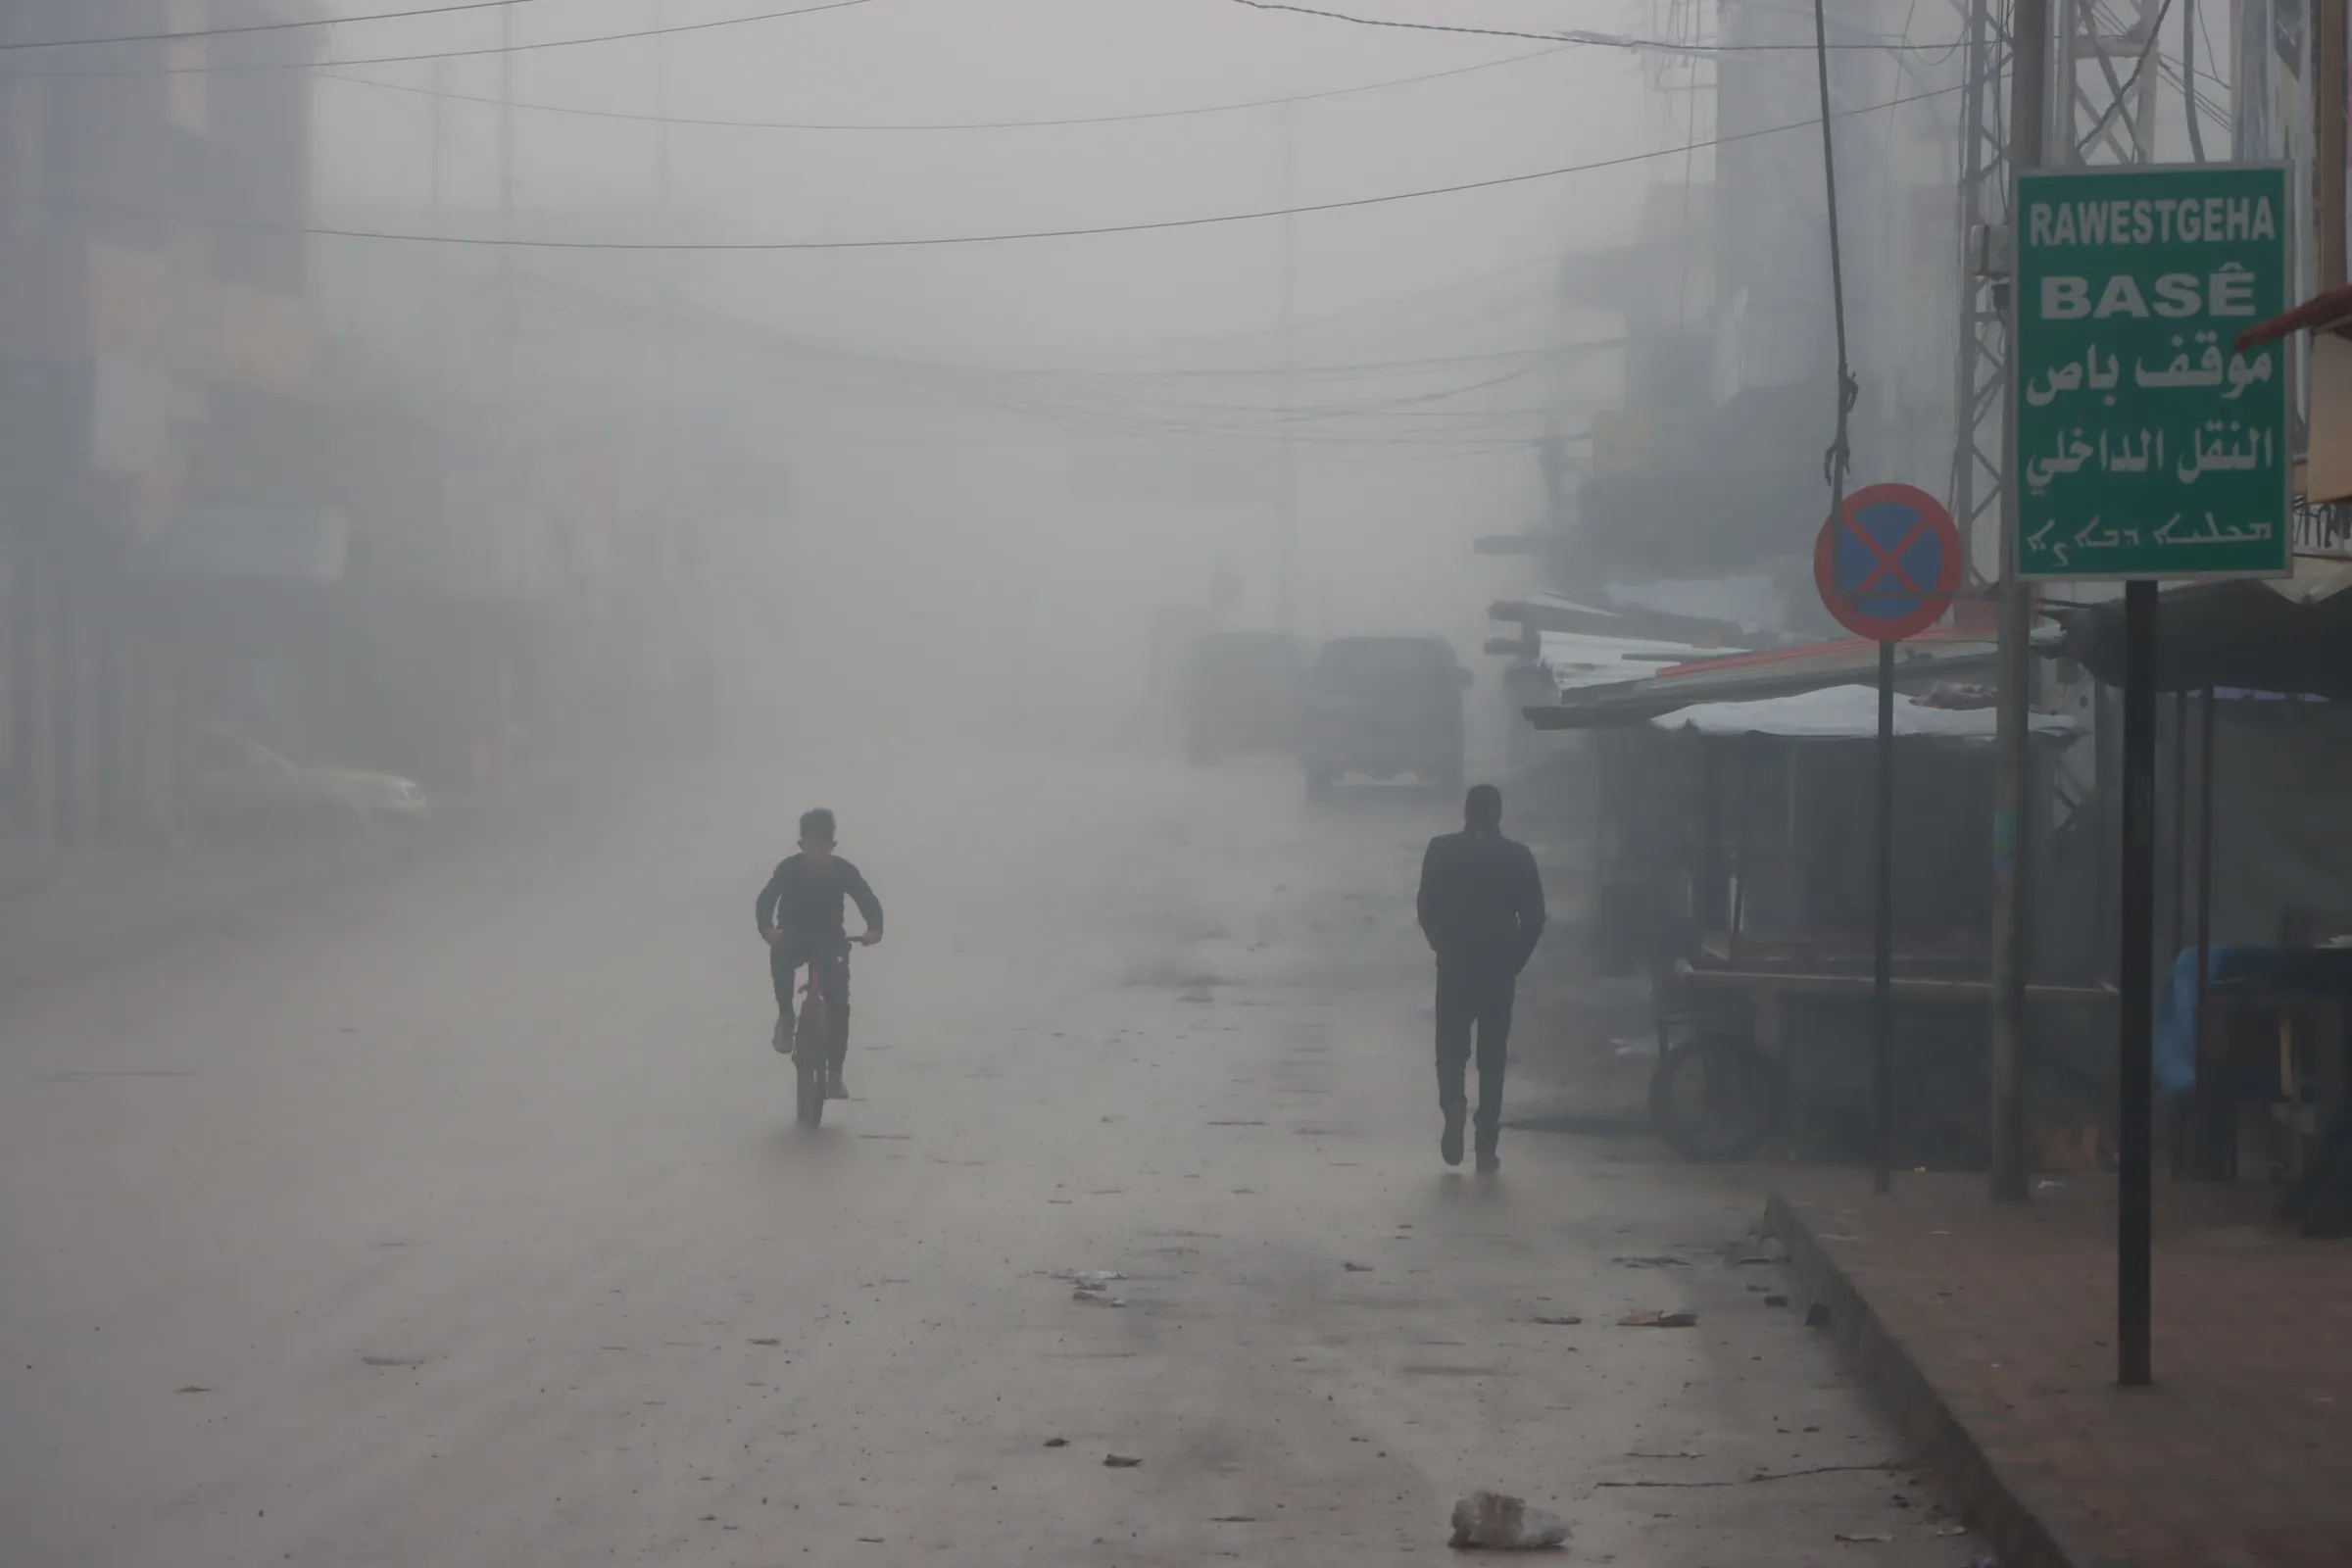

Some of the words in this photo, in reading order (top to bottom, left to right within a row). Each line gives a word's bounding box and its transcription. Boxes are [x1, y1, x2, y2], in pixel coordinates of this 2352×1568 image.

[2029, 198, 2276, 245] RAWESTGEHA
[2040, 262, 2256, 318] BASÊ
[2027, 344, 2119, 406] باص
[2135, 330, 2272, 399] موقف
[2026, 425, 2163, 496] الداخلي
[2178, 419, 2272, 484] النقل
